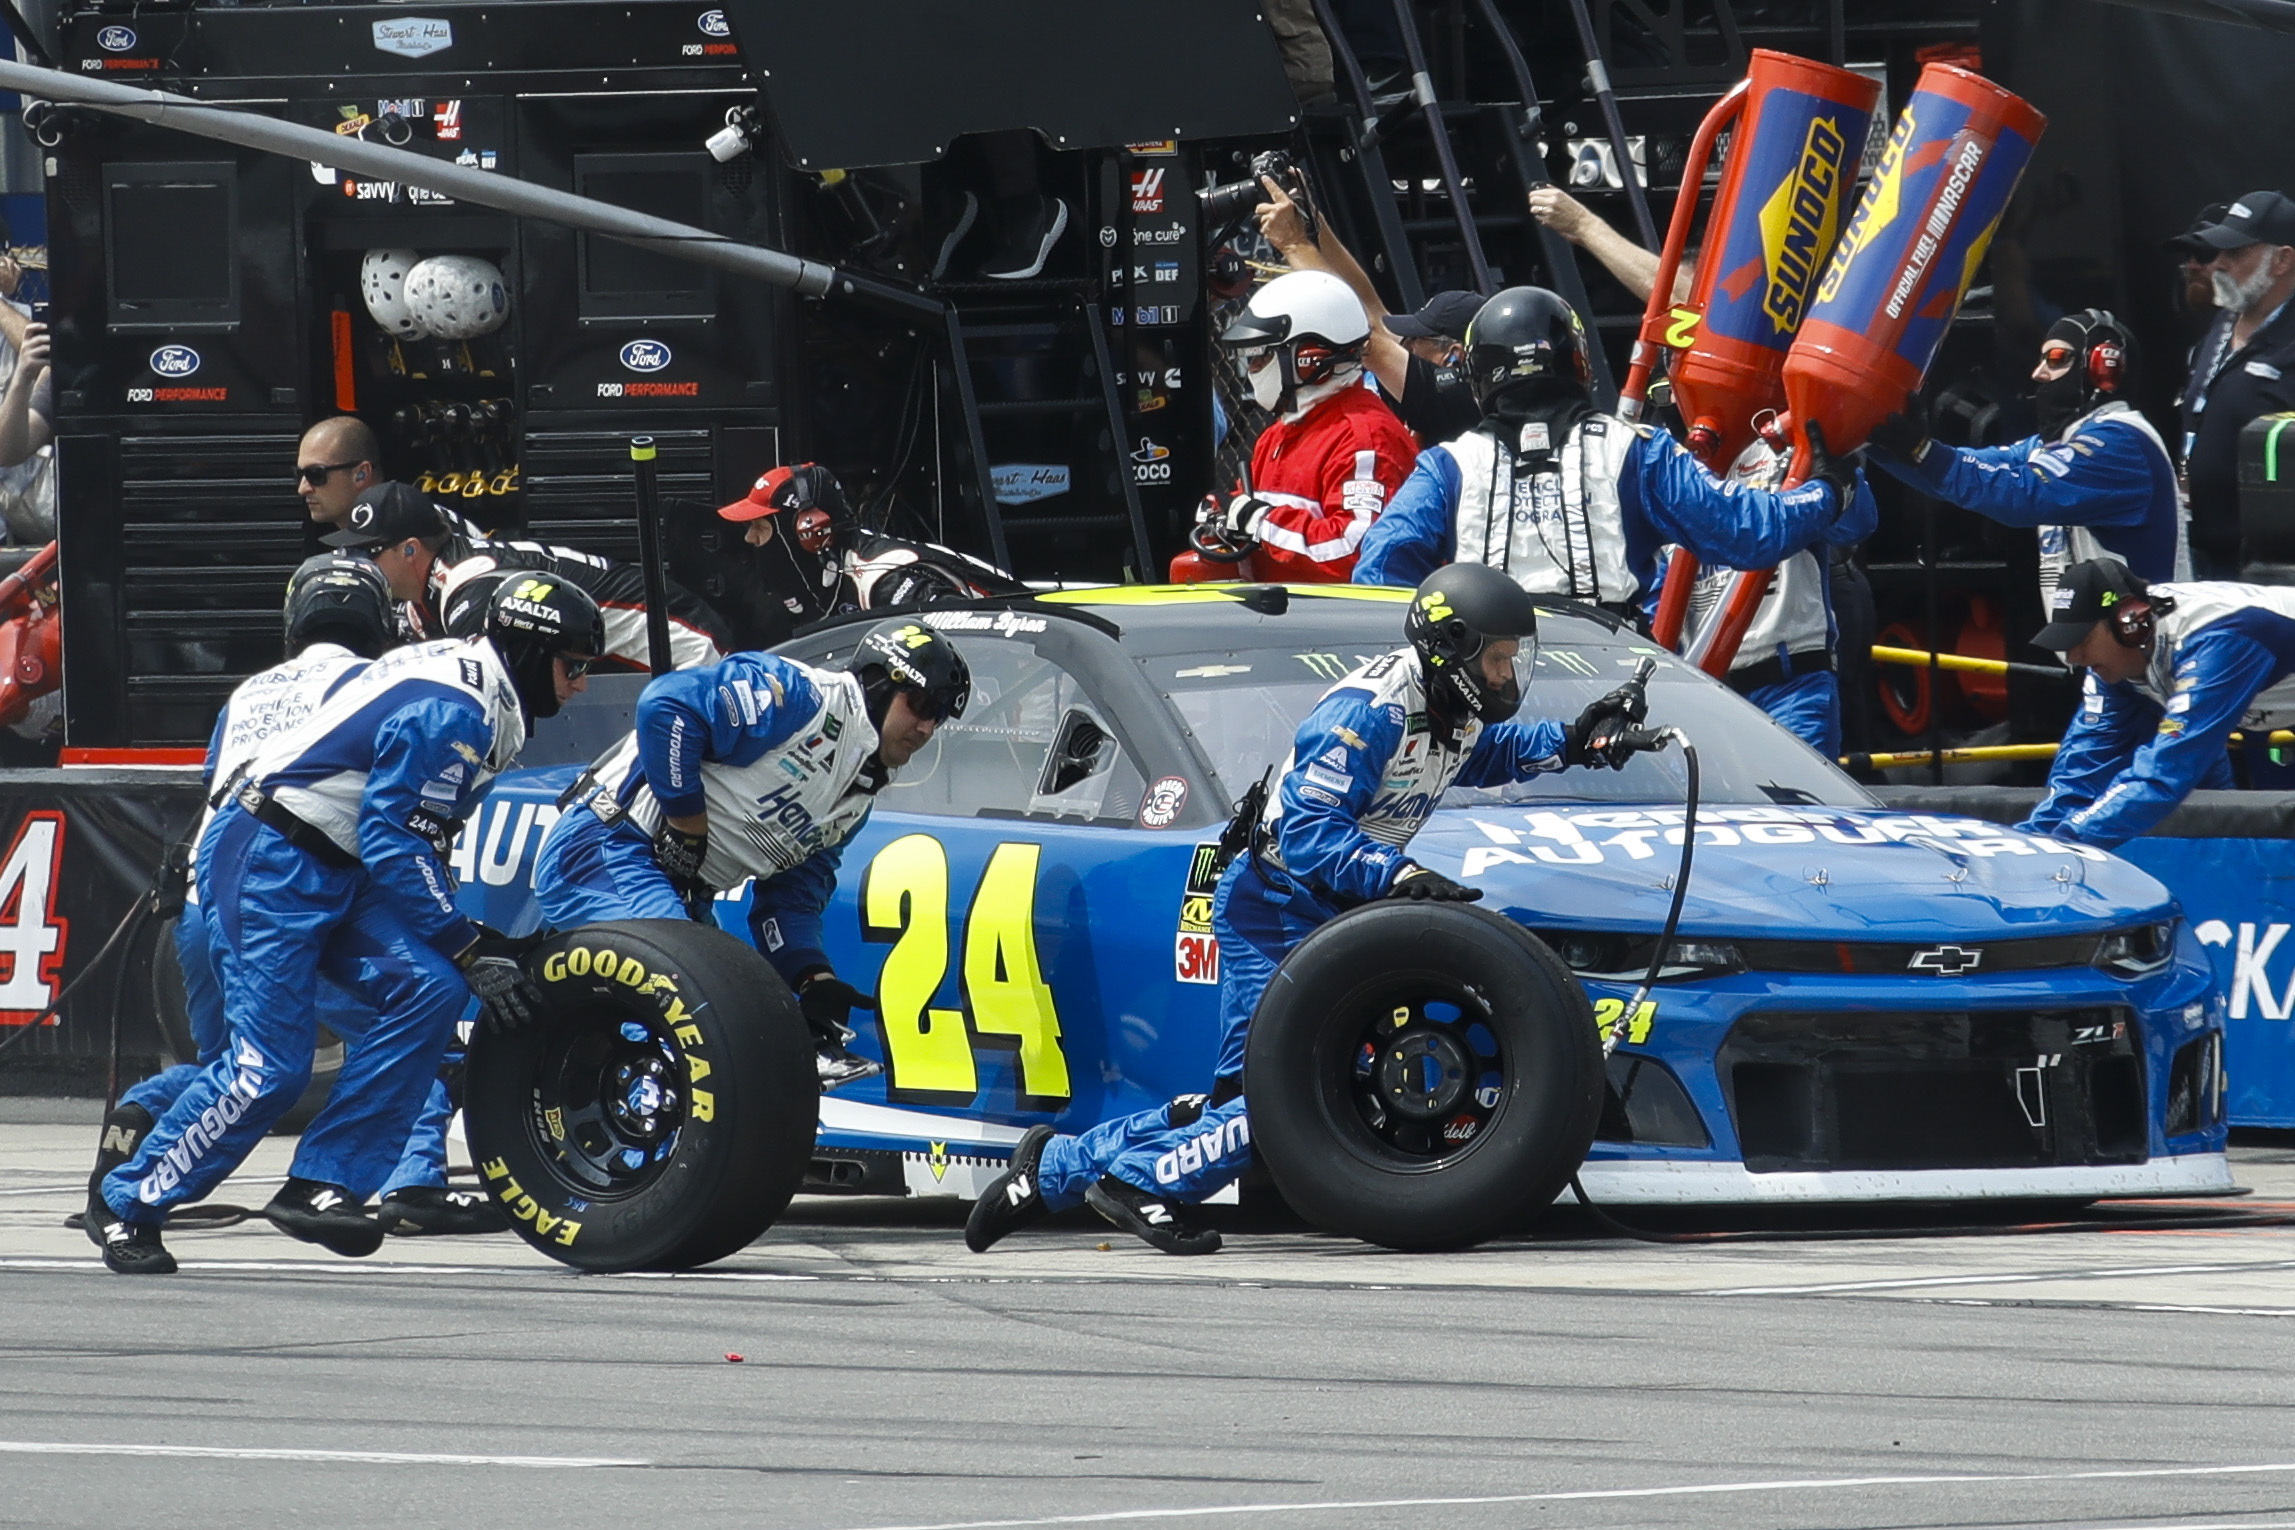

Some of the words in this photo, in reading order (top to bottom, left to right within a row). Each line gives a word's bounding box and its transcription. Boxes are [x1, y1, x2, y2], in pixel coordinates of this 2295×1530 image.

[682, 45, 703, 55] FORD
[82, 59, 102, 70] FORD
[357, 182, 394, 203] savvy
[1938, 141, 1983, 217] NASCAR
[1155, 230, 1180, 242] cure
[1768, 122, 1843, 328] SUNOCO
[1155, 269, 1178, 281] DEF
[1885, 265, 1920, 319] OFFICIAL
[1912, 233, 1937, 268] FUEL
[1112, 306, 1158, 325] Mbil
[159, 350, 191, 371] Ford
[630, 344, 661, 366] Ford
[597, 384, 622, 397] FORD
[625, 382, 699, 396] PERFORMANCE
[1116, 371, 1156, 387] svy
[127, 389, 152, 402] FORD
[155, 387, 227, 401] PERFORMANCE
[514, 579, 554, 603] 24
[501, 597, 561, 624] AXALTA
[1421, 591, 1453, 622] 24
[922, 611, 993, 630] William
[993, 612, 1047, 638] Byron
[888, 656, 927, 688] AXALTA
[250, 692, 303, 715] VEHICE
[1450, 673, 1484, 712] AXALTA
[231, 717, 305, 748] PROGAMS
[669, 714, 685, 789] AUTOGUARD
[449, 800, 562, 891] AUT
[865, 833, 1071, 1098] 24
[1178, 937, 1218, 981] 3M
[1594, 998, 1657, 1044] 24
[2072, 1022, 2125, 1045] ZL1
[138, 1036, 264, 1204] AUTOGUARD
[1156, 1115, 1250, 1185] UARD
[480, 1157, 582, 1247] EAGLE
